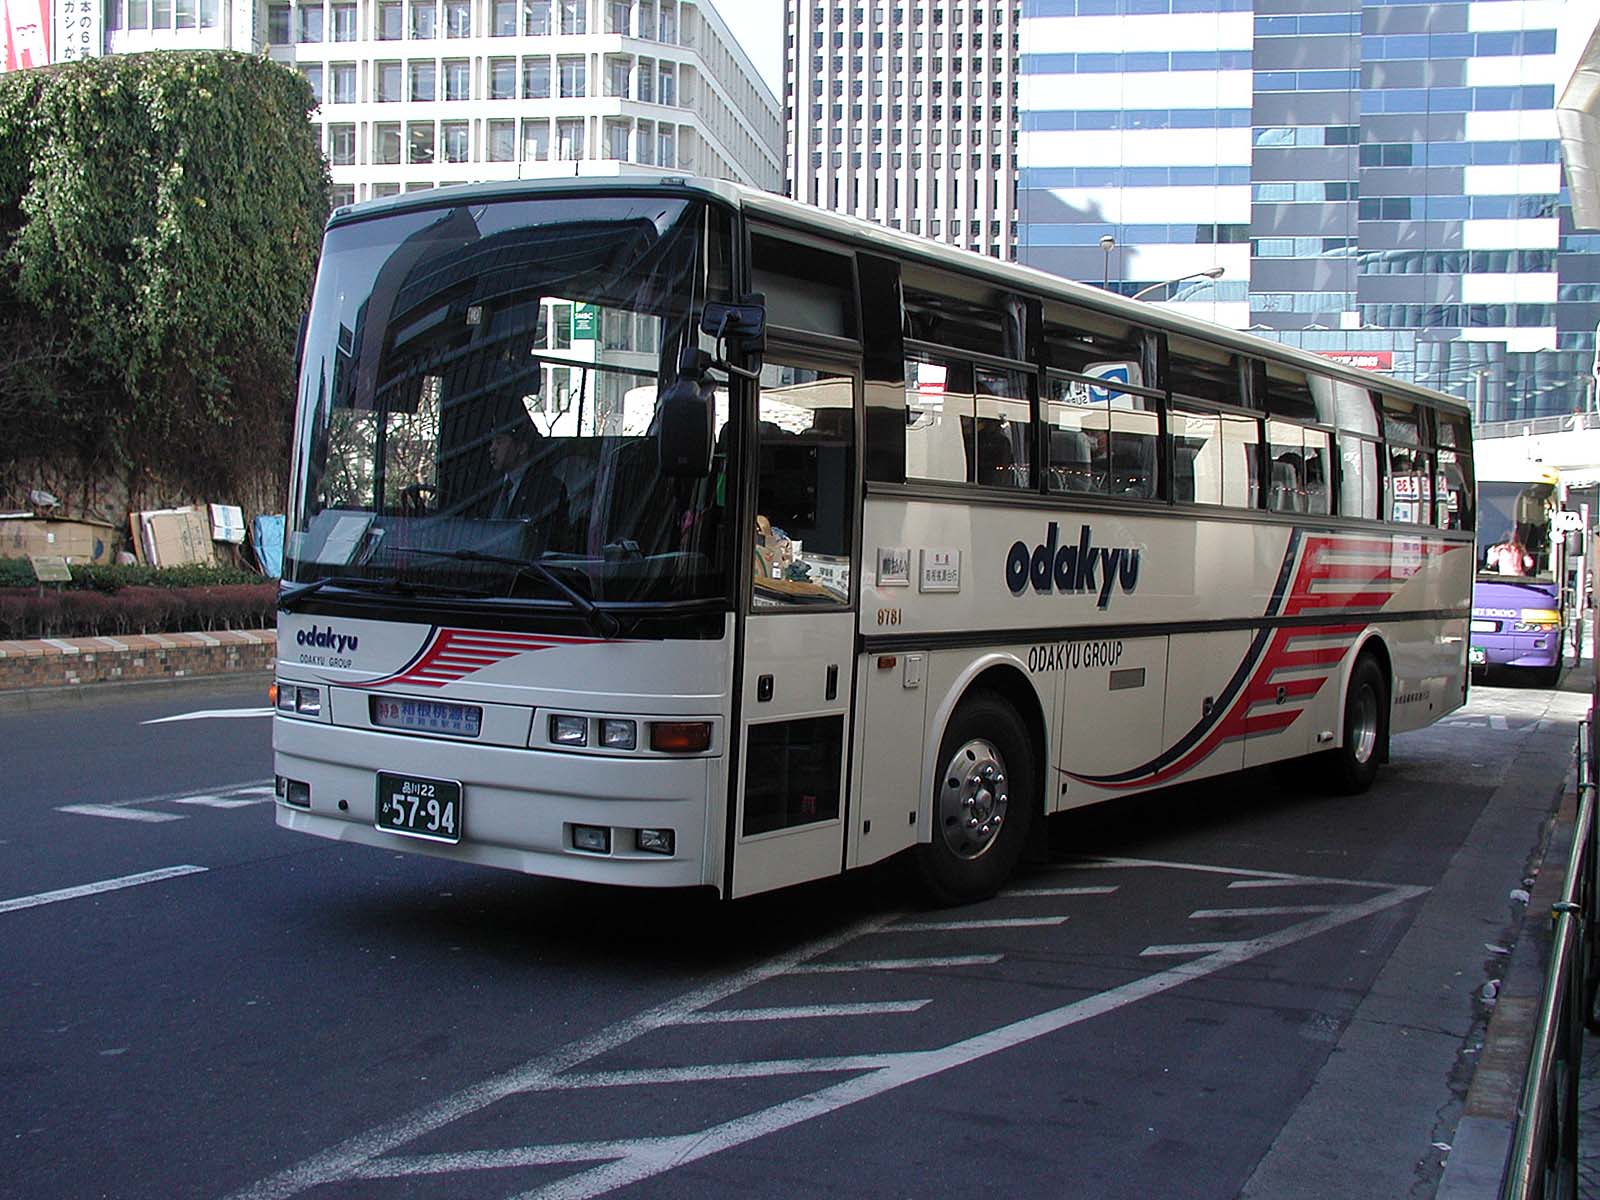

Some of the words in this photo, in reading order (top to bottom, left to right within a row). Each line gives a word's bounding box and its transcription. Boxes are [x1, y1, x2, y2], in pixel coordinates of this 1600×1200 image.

[1005, 521, 1141, 610] odakyu
[296, 624, 358, 654] odakyu
[299, 653, 326, 666] ODAKYU
[329, 656, 353, 669] GROUP
[1028, 642, 1080, 673] ODAKYU
[1083, 640, 1123, 668] GROUP
[392, 793, 455, 834] 57-94
